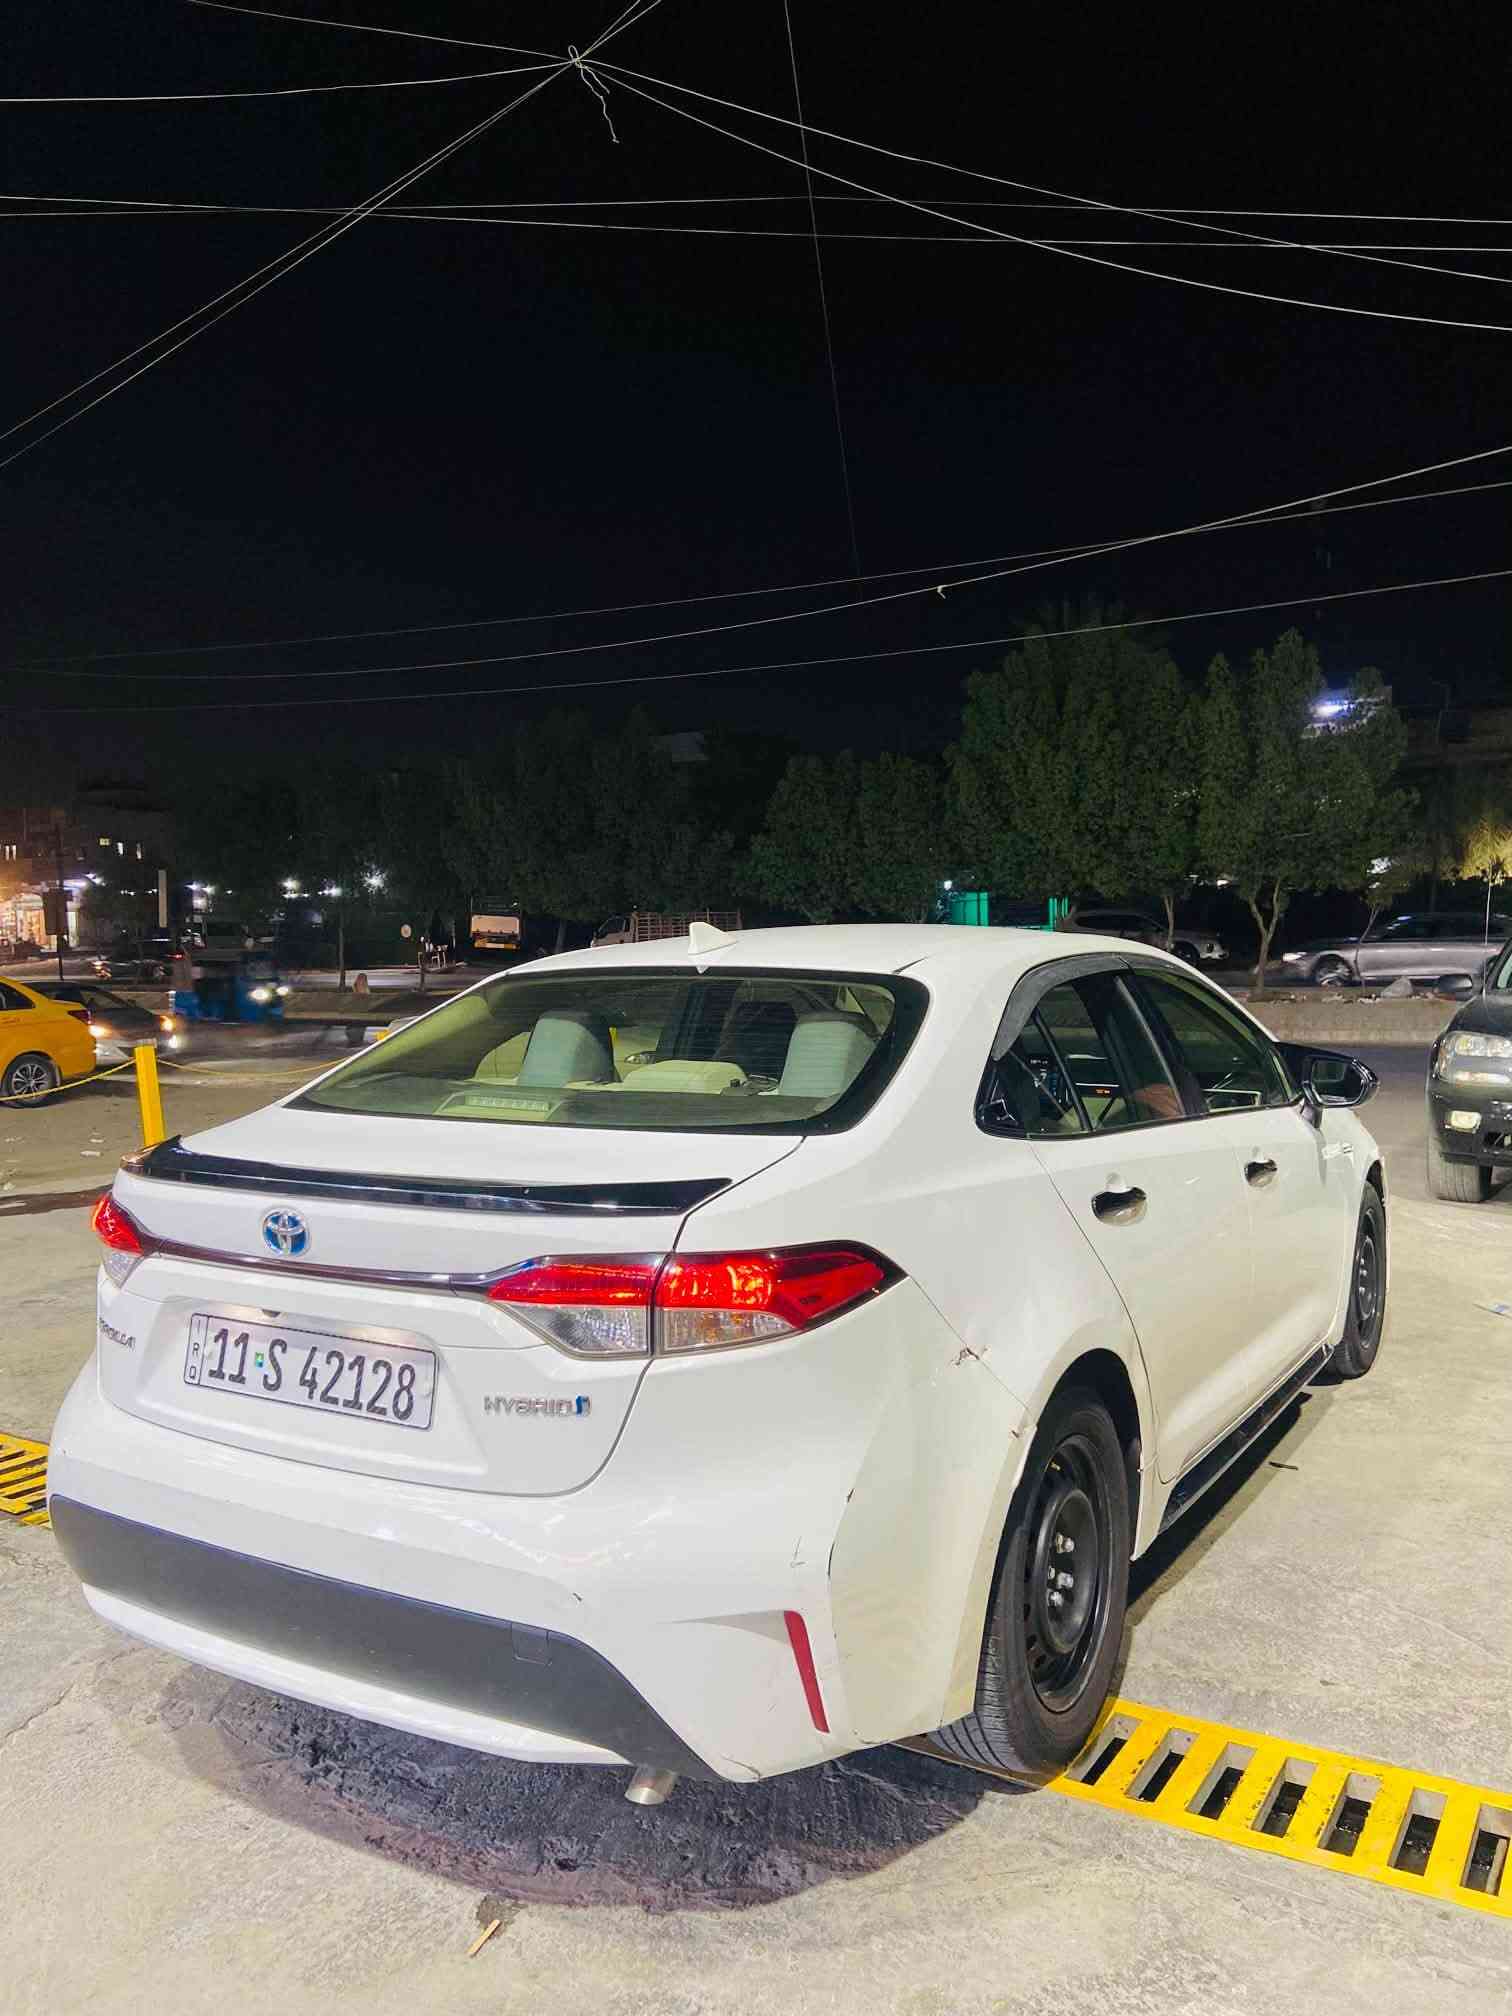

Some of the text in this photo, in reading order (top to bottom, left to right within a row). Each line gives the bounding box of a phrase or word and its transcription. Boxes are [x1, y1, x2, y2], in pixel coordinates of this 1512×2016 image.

[208, 1327, 416, 1421] 11 S 42128
[484, 1396, 574, 1416] HYBRID
